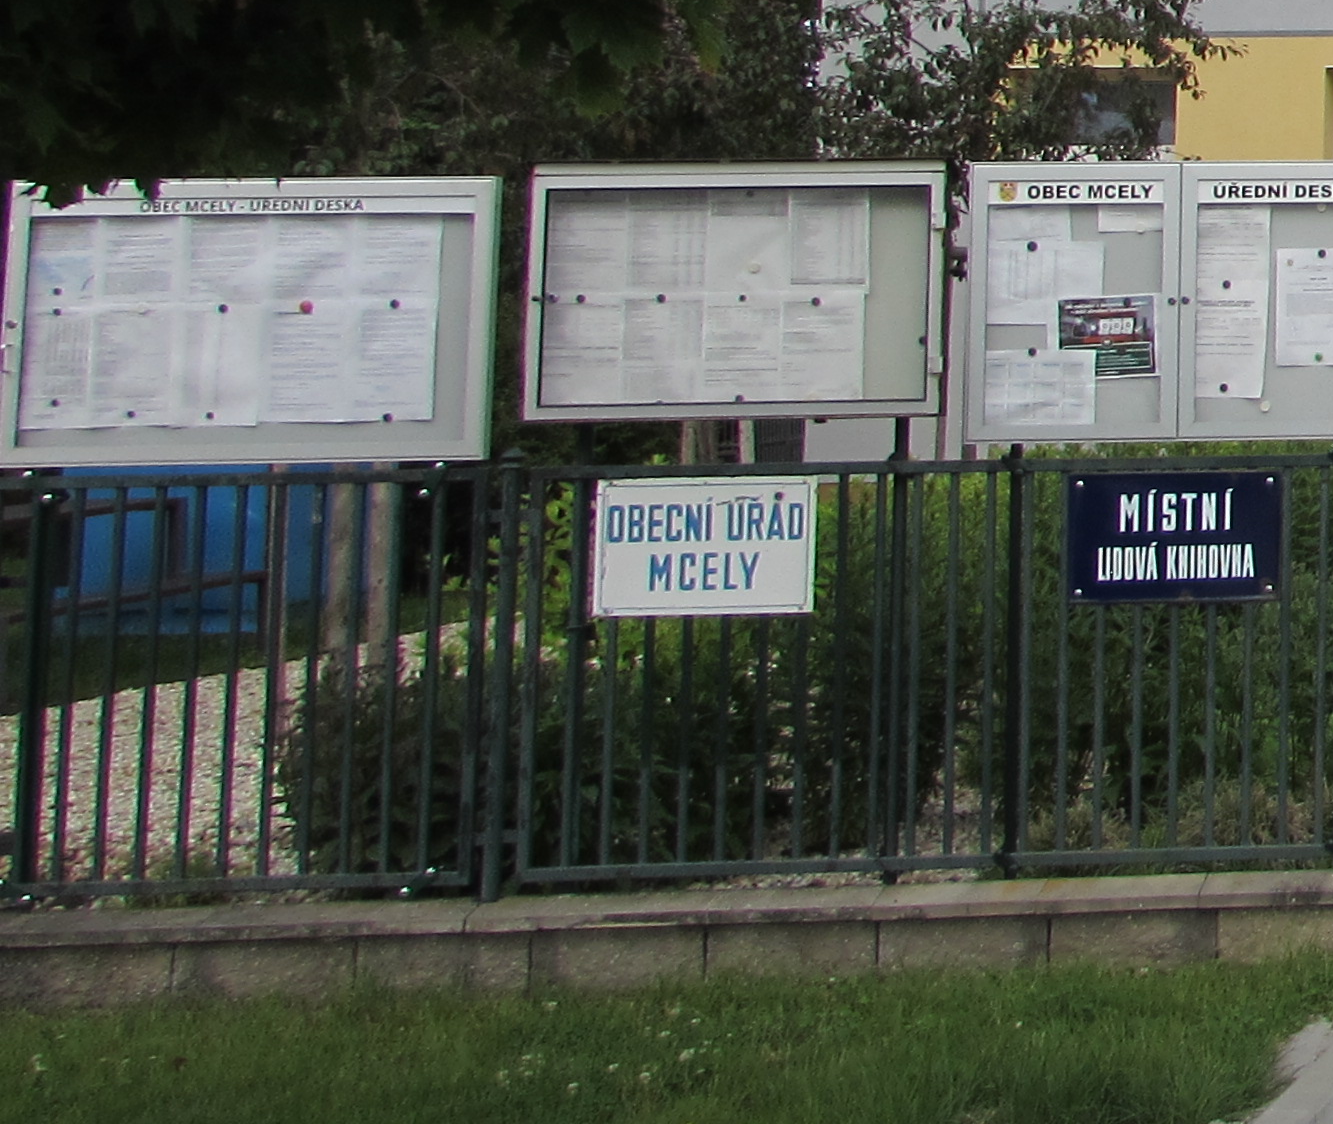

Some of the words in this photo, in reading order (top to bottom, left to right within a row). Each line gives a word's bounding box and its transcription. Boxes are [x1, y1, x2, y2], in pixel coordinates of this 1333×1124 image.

[140, 199, 180, 213] OBEC
[185, 199, 237, 213] MCELY
[314, 197, 364, 211] DESKA
[1027, 184, 1082, 200] OBEC
[1087, 184, 1155, 200] MCELY
[1213, 181, 1288, 199] ÚŘEDNÍ
[608, 496, 715, 543] OBECNÍ
[1119, 487, 1235, 533] MÍSTNÍ
[648, 551, 761, 592] MCELY
[1097, 541, 1159, 582] LIDOVÁ
[1165, 542, 1255, 581] KNIHOVNA
